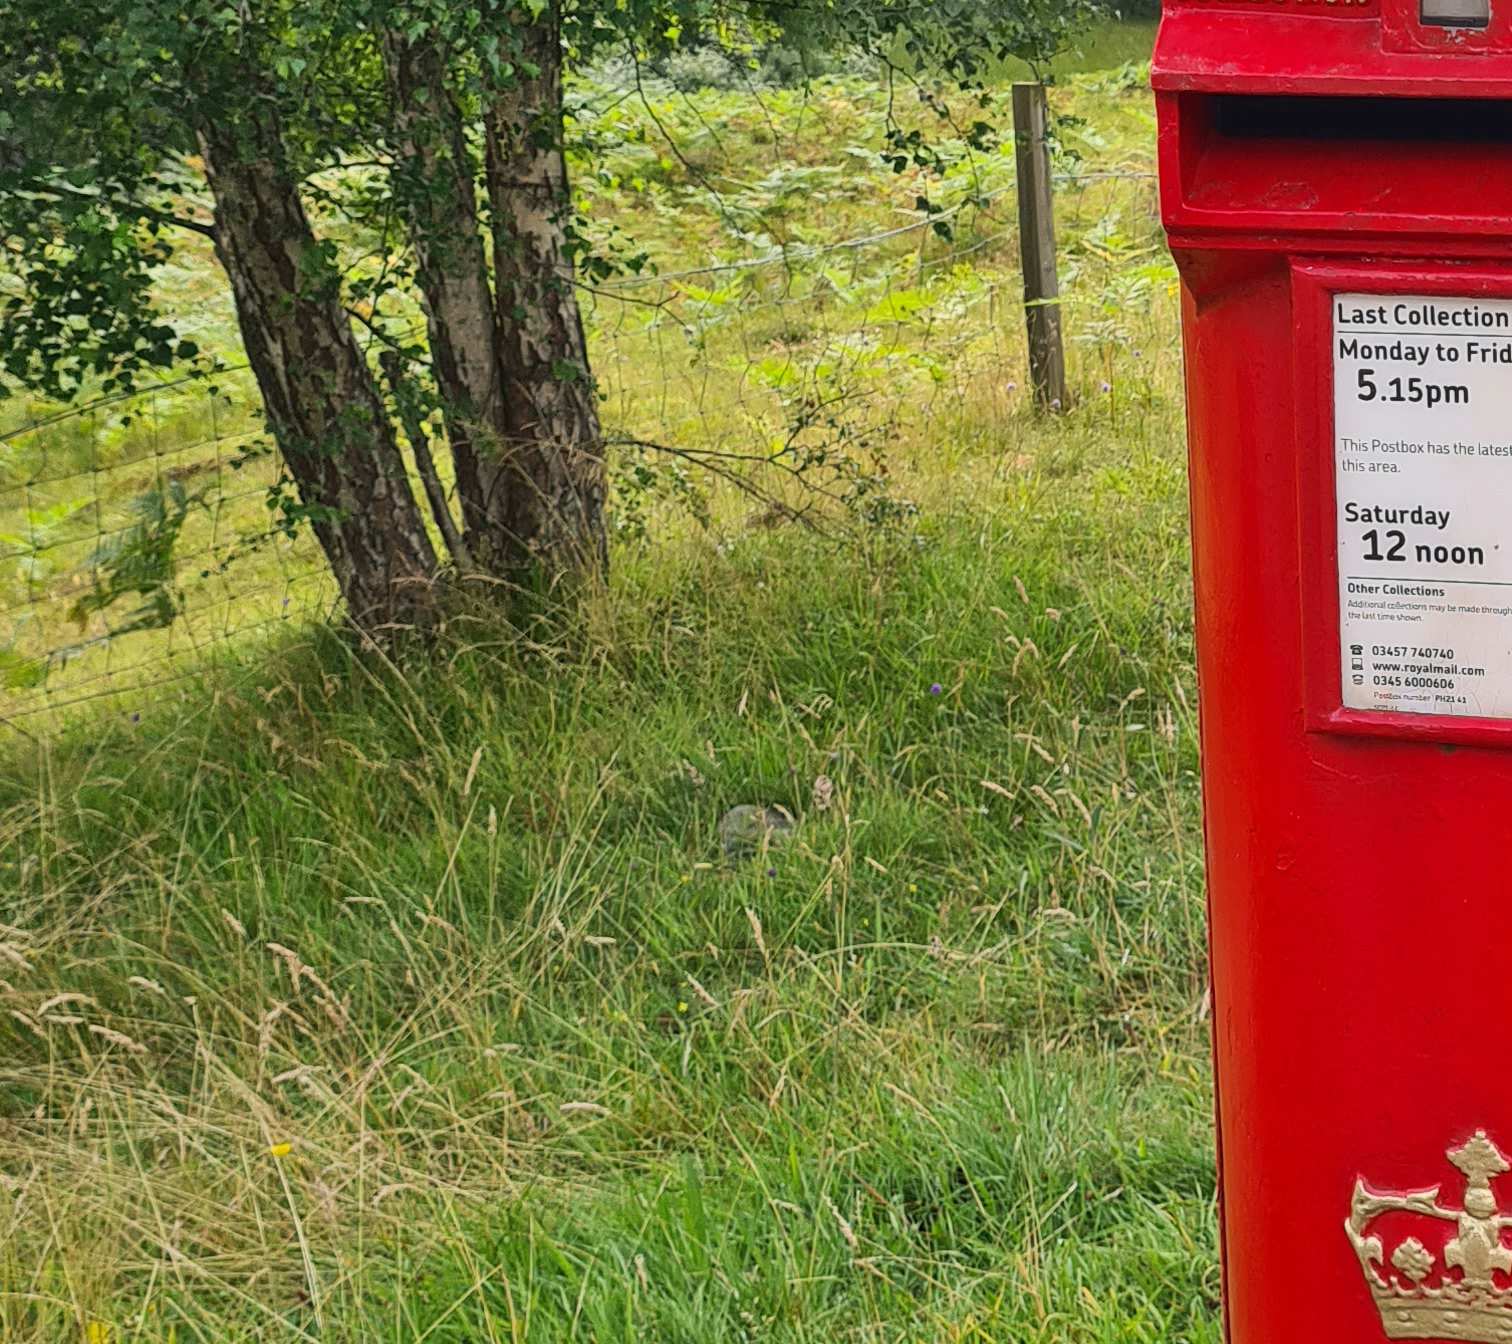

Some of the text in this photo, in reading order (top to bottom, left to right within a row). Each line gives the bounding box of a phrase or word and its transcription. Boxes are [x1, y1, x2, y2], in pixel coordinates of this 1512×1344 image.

[1337, 303, 1387, 325] Last
[1394, 305, 1508, 328] Collection
[1339, 339, 1429, 365] Monday
[1436, 344, 1459, 362] to
[1357, 368, 1469, 408] 5.15pm
[1341, 438, 1368, 453] This
[1372, 439, 1424, 454] Postbox
[1427, 441, 1450, 455] has
[1454, 442, 1474, 456] the
[1342, 459, 1401, 473] this area.
[1345, 503, 1450, 529] Saturday
[1362, 529, 1484, 565] 12 noon
[1347, 582, 1446, 597] Other Collections
[1347, 599, 1386, 609] Additional
[1388, 602, 1427, 610] collections
[1429, 605, 1446, 613] may
[1448, 604, 1456, 612] be
[1458, 605, 1481, 613] made
[1347, 611, 1361, 620] the
[1362, 612, 1377, 621] last
[1378, 613, 1395, 621] time
[1372, 645, 1454, 660] 03457 740740
[1372, 663, 1485, 677] www.royalmail.com
[1373, 675, 1455, 690] 0345 6000606
